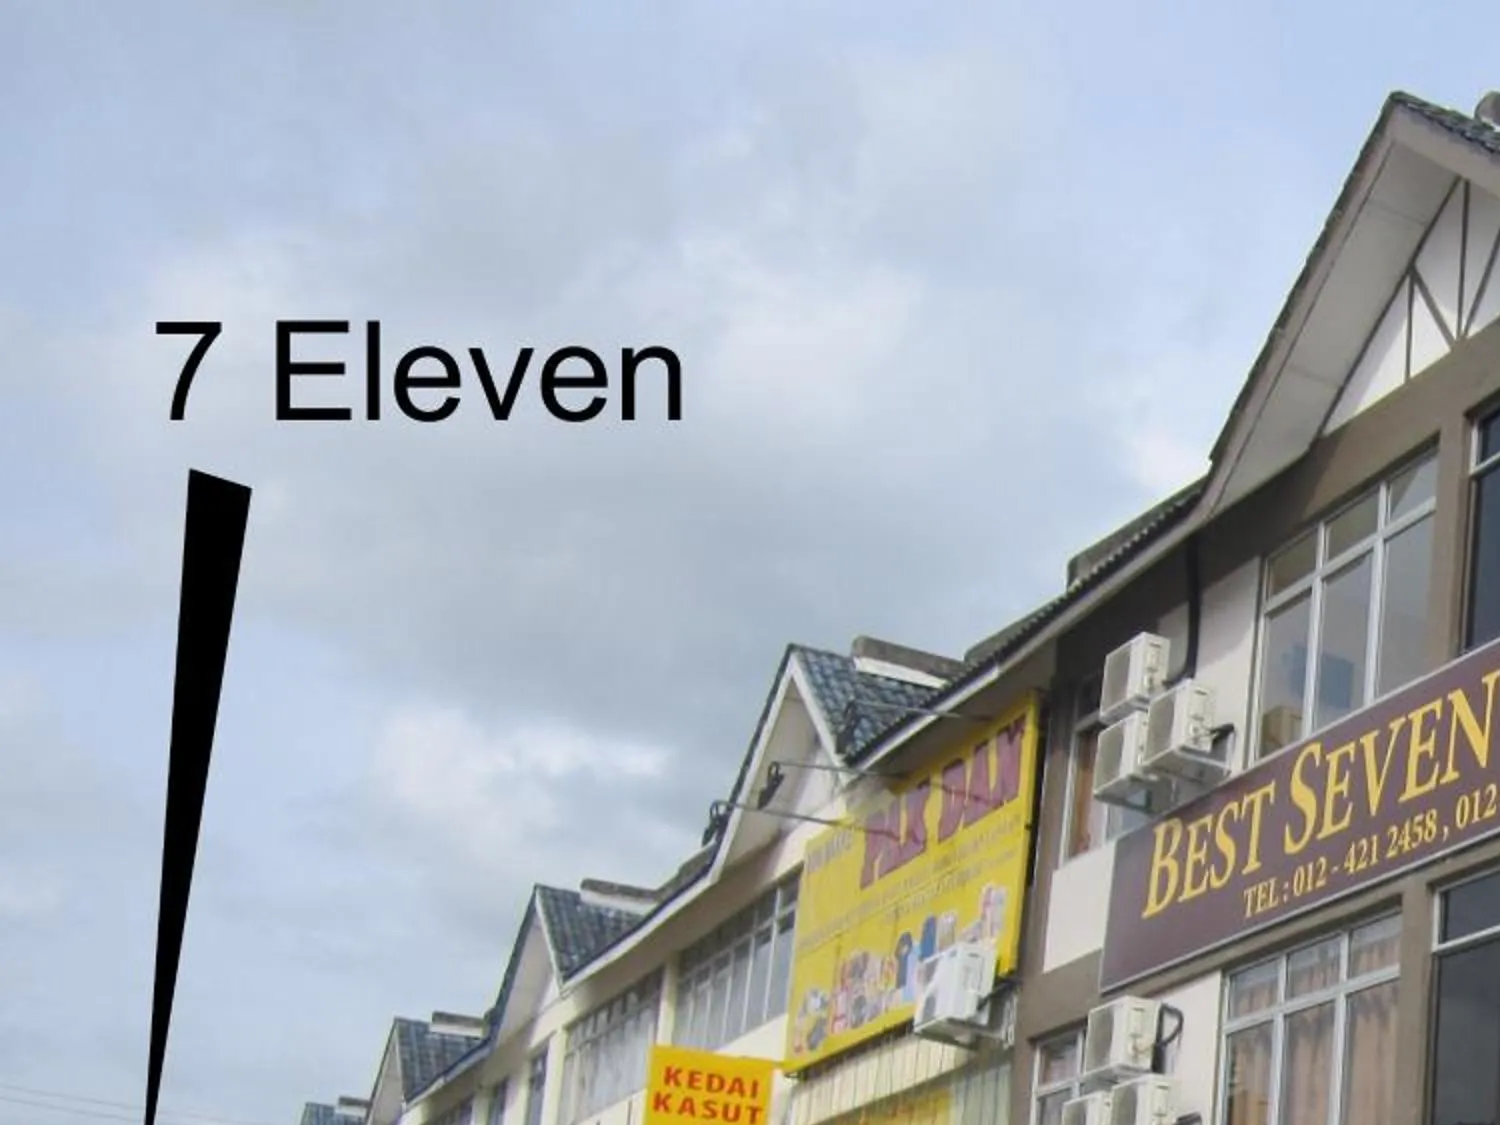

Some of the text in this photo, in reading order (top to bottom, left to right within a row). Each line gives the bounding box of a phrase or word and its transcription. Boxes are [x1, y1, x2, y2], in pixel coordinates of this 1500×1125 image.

[1142, 781, 1276, 919] BEST
[1344, 834, 1379, 873] 421
[1455, 784, 1498, 829] 012
[653, 1091, 763, 1125] KASUT
[664, 1065, 759, 1099] KEDAI
